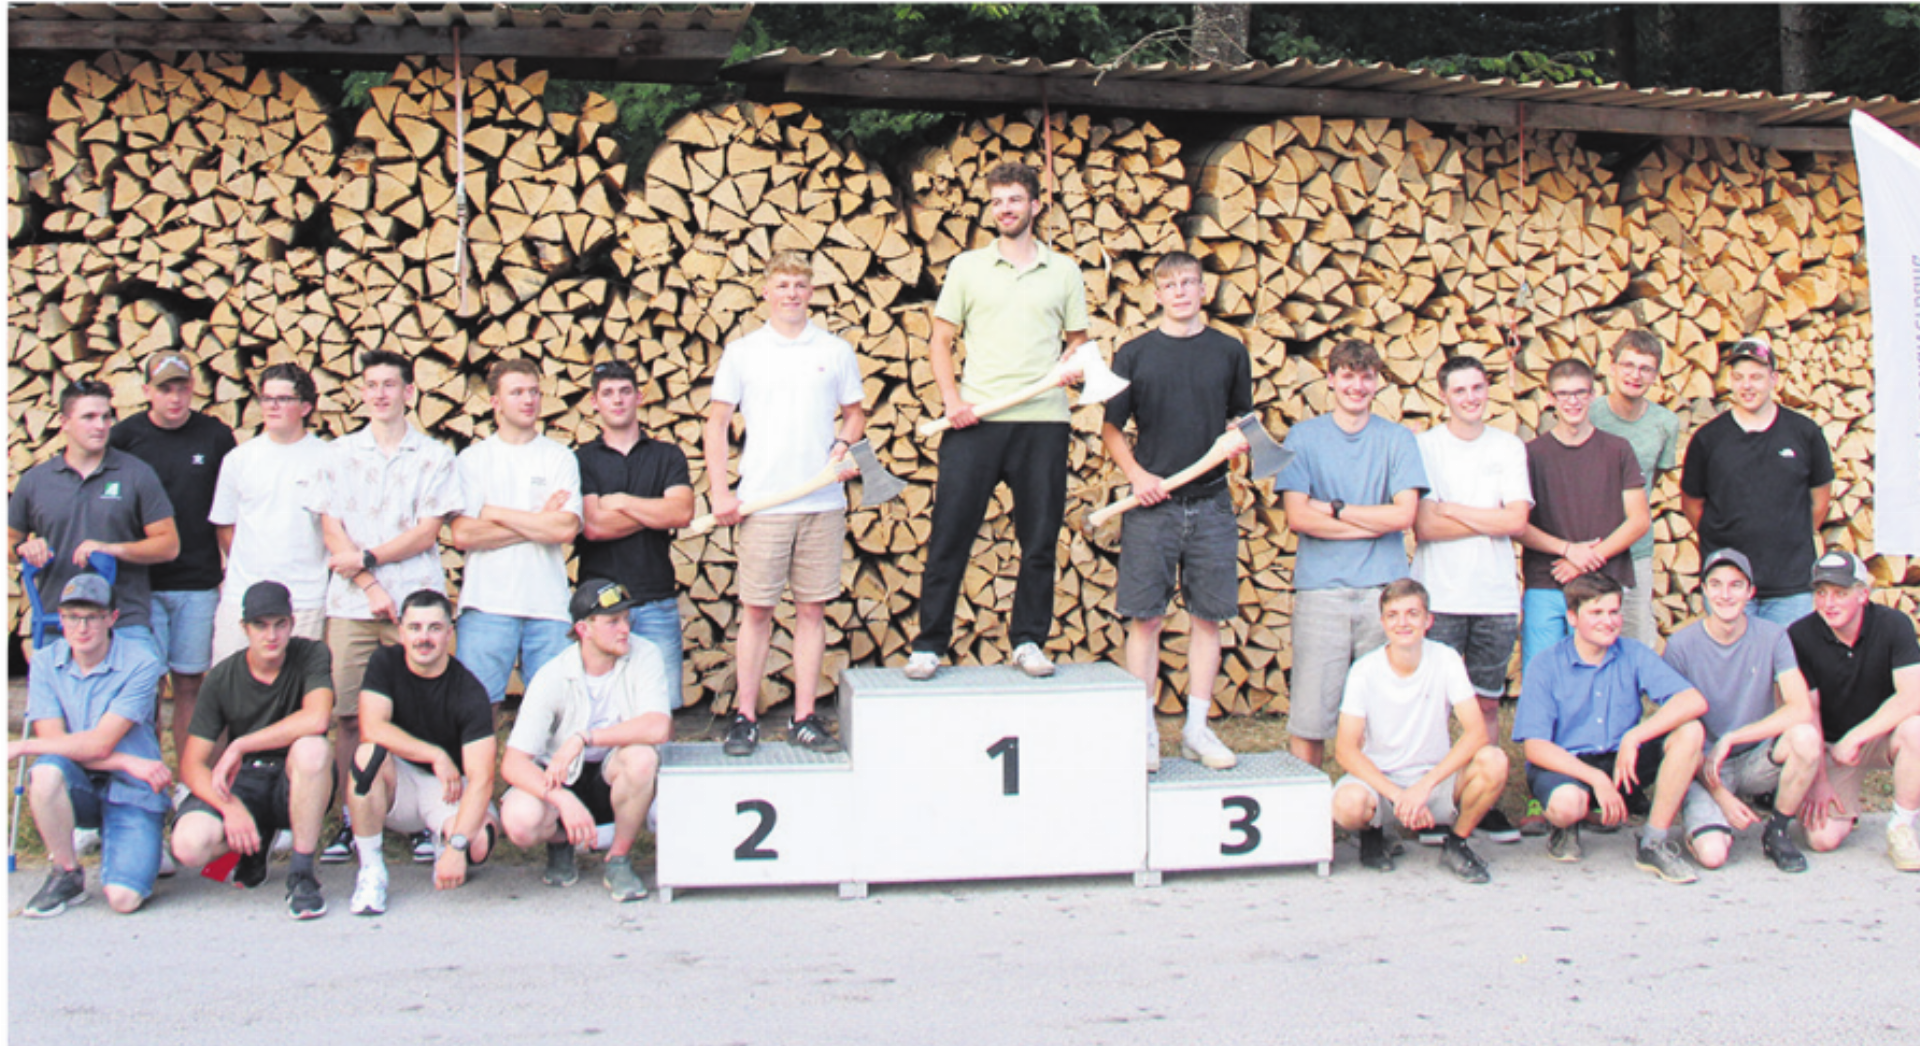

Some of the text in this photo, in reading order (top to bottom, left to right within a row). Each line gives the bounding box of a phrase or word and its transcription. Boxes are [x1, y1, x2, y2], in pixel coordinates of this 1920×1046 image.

[986, 736, 1019, 795] 1
[734, 799, 778, 860] 2
[1220, 795, 1262, 856] 3
